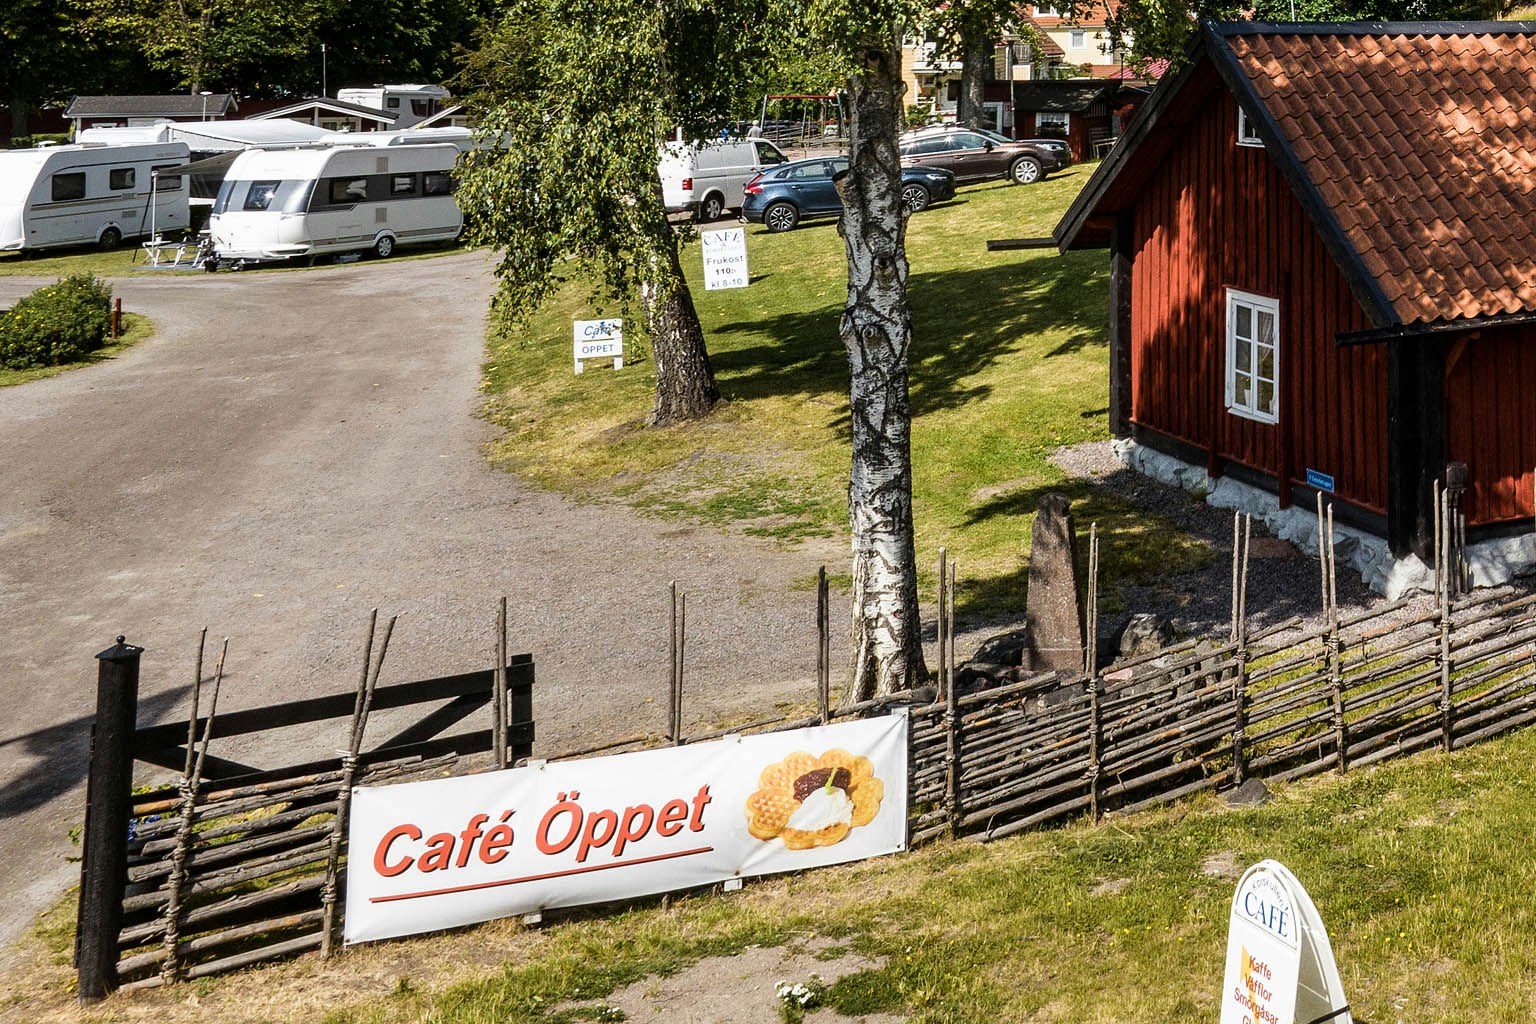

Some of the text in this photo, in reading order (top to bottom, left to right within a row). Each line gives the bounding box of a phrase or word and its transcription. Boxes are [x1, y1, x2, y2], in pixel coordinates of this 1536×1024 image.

[706, 255, 743, 265] Frukost
[715, 267, 737, 275] 110:-
[722, 278, 743, 287] 8-10
[373, 783, 712, 878] Café Öppet
[1244, 891, 1289, 938] CAFÉ
[1248, 954, 1272, 980] Kaffe
